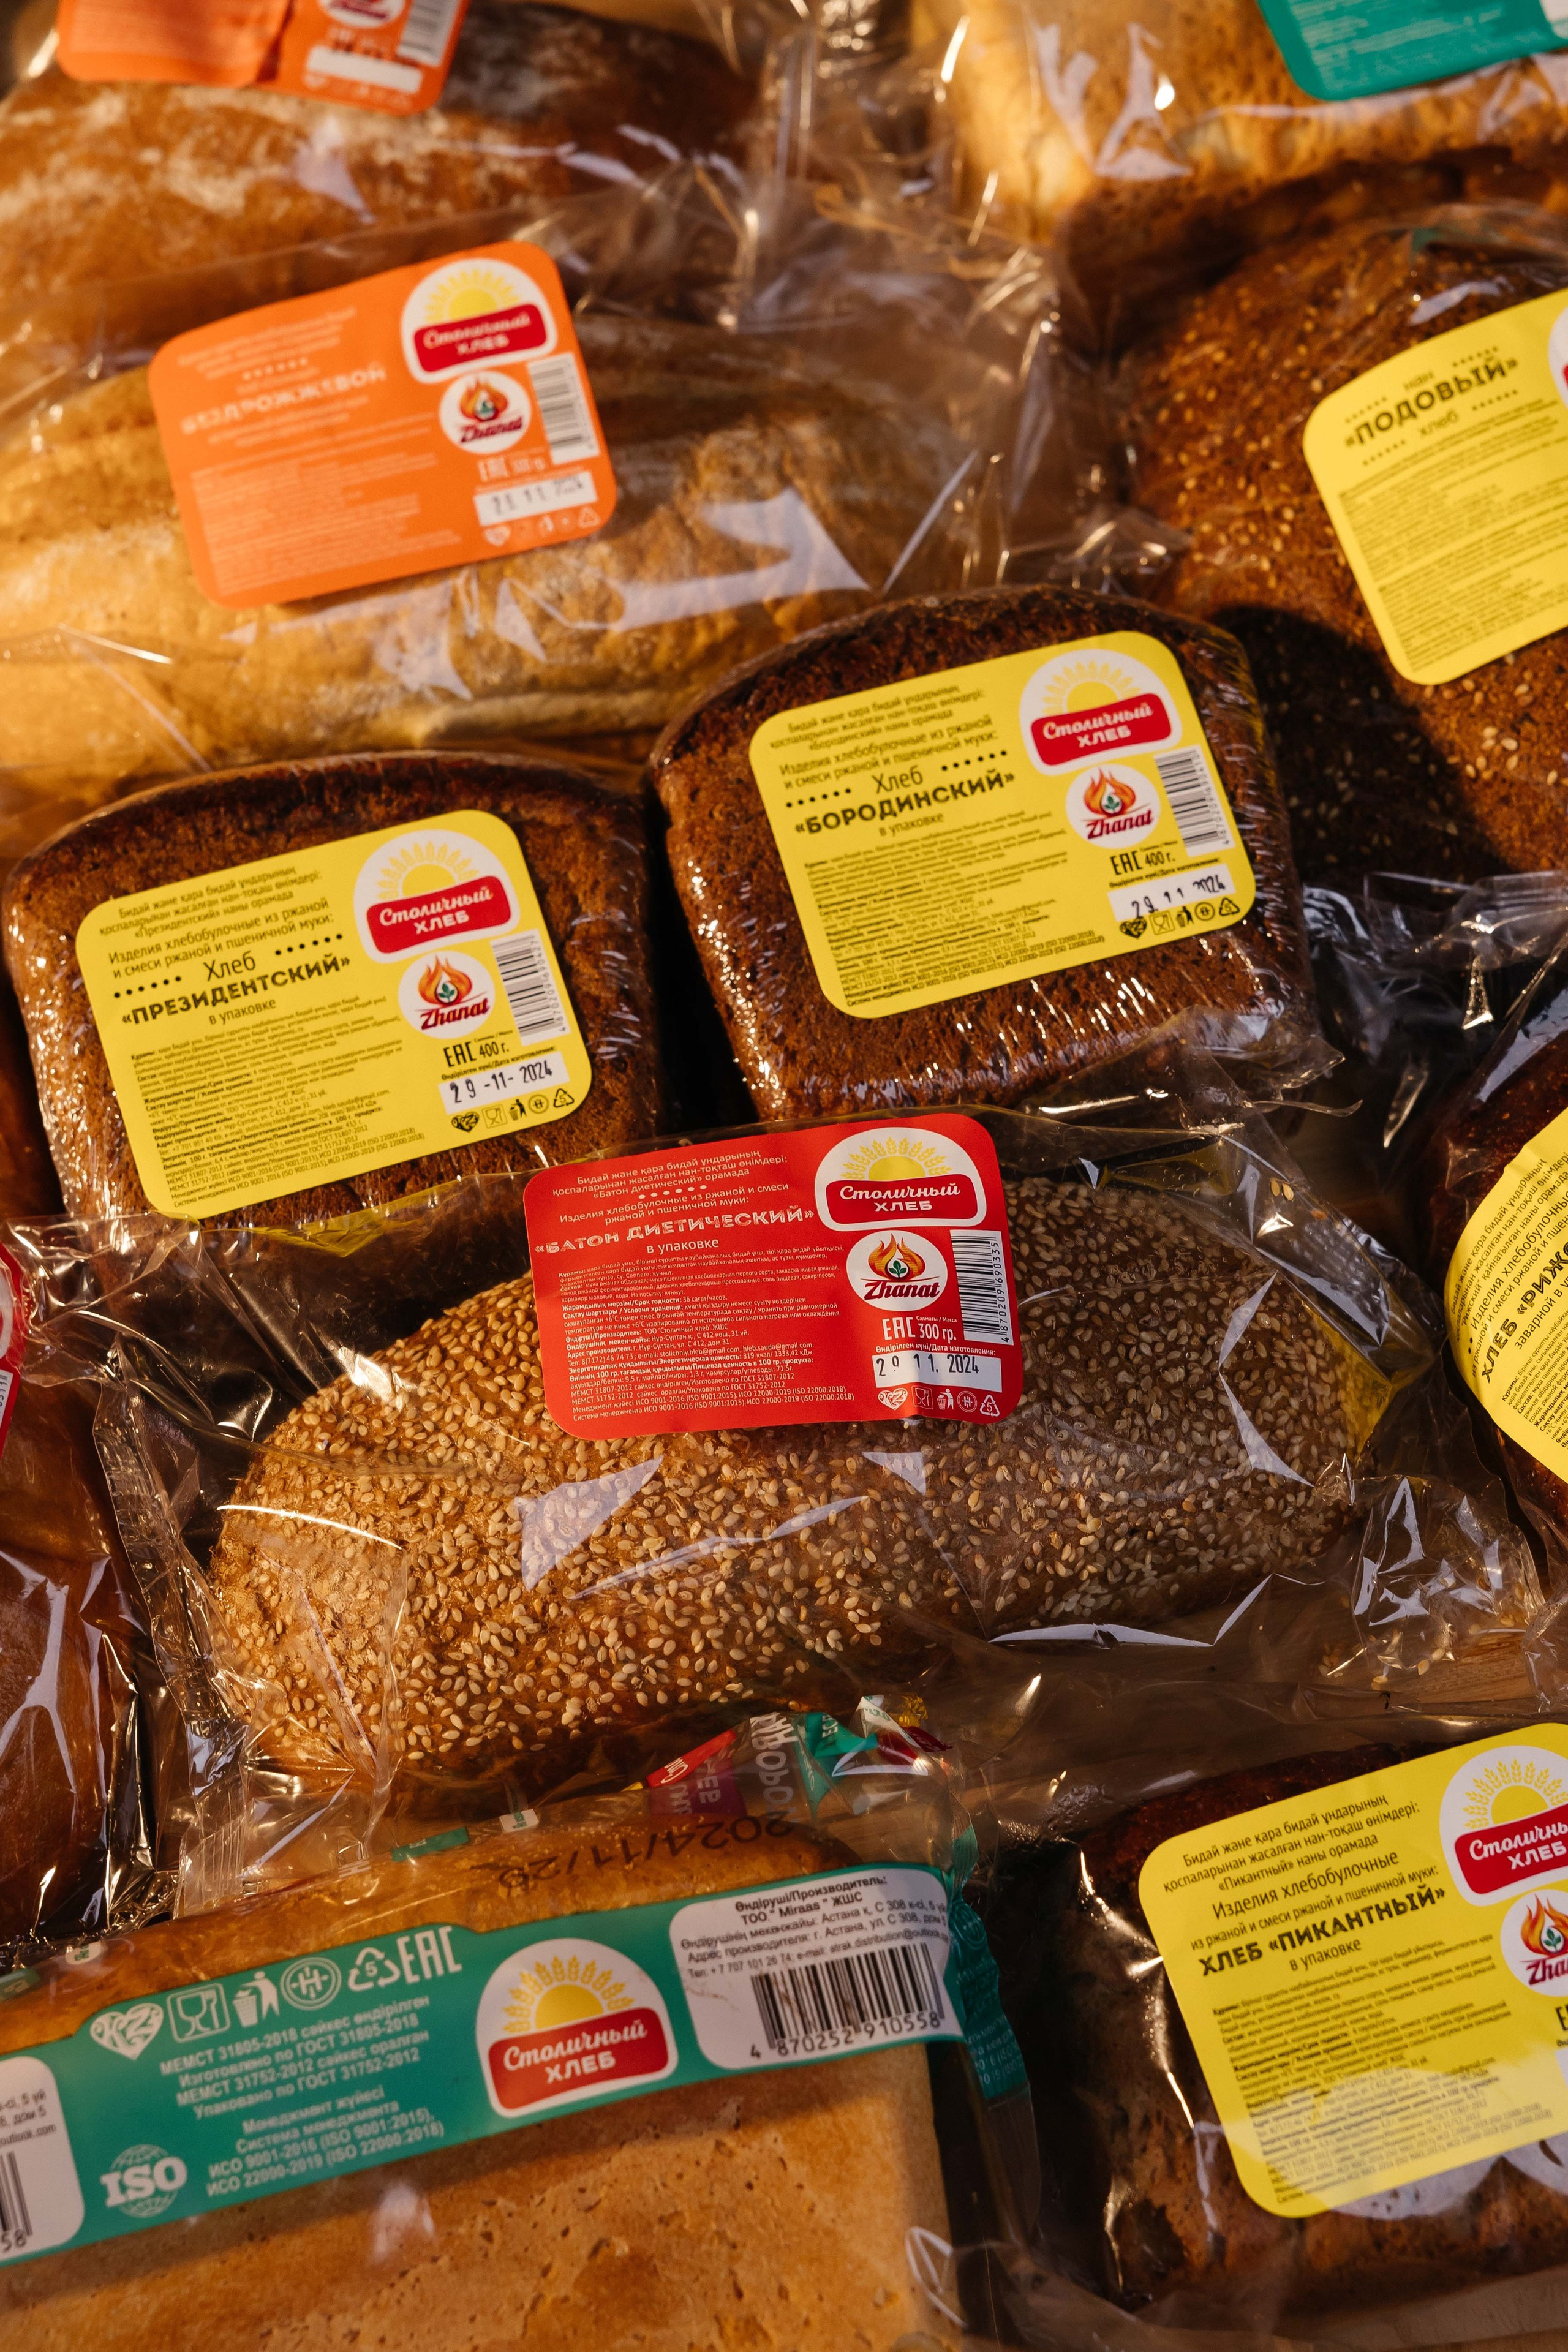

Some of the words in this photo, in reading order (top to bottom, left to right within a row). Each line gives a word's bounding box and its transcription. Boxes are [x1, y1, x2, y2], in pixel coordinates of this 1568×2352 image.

[1346, 359, 1518, 446] «ПОДОВЫЙ»
[1042, 702, 1153, 740] Столичный
[1075, 729, 1131, 748] ХЛЕБ
[872, 764, 924, 794] Хлеб
[795, 768, 1014, 834] «БОРОДИНСКИЙ»
[878, 826, 887, 837] в
[888, 813, 943, 837] упаковке
[1085, 809, 1152, 840] Zhanat
[1144, 850, 1165, 867] 400
[1165, 851, 1175, 863] г.
[379, 886, 493, 927] Столичный
[413, 914, 470, 935] ХЛЕБ
[107, 943, 162, 965] Изделия
[164, 916, 261, 951] хлебобулочные
[263, 912, 279, 924] из
[281, 897, 329, 922] ржаной
[112, 968, 122, 979] и
[124, 958, 162, 976] смеси
[164, 942, 212, 968] ржаной
[214, 942, 223, 952] и
[225, 923, 296, 949] пшеничной
[298, 913, 334, 931] муки:
[203, 950, 256, 982] Хлеб
[121, 952, 350, 1025] «ПРЕЗИДЕНТСКИЙ»
[208, 1014, 217, 1025] в
[218, 999, 276, 1024] упаковке
[420, 998, 489, 1030] Zhanat
[478, 1041, 499, 1058] 400
[500, 1042, 510, 1054] г.
[552, 1179, 627, 1197] қоспаларынан
[628, 1171, 676, 1185] жасалған
[677, 1161, 737, 1177] нан-тоқташ
[738, 1154, 788, 1167] өнімдері:
[576, 1172, 609, 1185] Бидай
[611, 1169, 638, 1180] және
[640, 1164, 664, 1175] қара
[666, 1157, 698, 1170] бидай
[699, 1150, 761, 1166] ұндарының
[592, 1187, 628, 1199] «Батон
[630, 1174, 703, 1194] диетический»
[704, 1168, 750, 1182] орамада
[559, 1210, 604, 1223] Изделия
[606, 1195, 688, 1215] хлебобулочные
[704, 1185, 745, 1203] ржаной
[756, 1183, 789, 1193] смеси
[839, 1182, 961, 1200] Столичный
[873, 1200, 933, 1212] ХЛЕБ
[533, 1232, 619, 1253] «БАТОН
[626, 1205, 815, 1242] ДИЕТИЧЕСКИЙ»
[604, 1208, 645, 1226] ржаной
[656, 1197, 717, 1214] пшеничной
[719, 1196, 749, 1207] муки:
[646, 1245, 654, 1254] в
[657, 1238, 719, 1255] упаковке
[990, 1242, 1004, 1283] 690335
[561, 1302, 607, 1312] Жарамдылық
[606, 1298, 650, 1308] мерзімі/Срок
[690, 1294, 726, 1302] сағат/часов.
[863, 1278, 940, 1301] Zhanat
[1471, 1277, 1504, 1330] Изделия
[1473, 1320, 1489, 1365] ржаной
[1488, 1314, 1494, 1323] и
[1492, 1283, 1515, 1314] смеси
[1512, 1246, 1543, 1286] ржаной
[1541, 1240, 1548, 1248] и
[996, 1289, 1009, 1332] 870209
[1515, 1296, 1556, 1350] заварной
[1554, 1289, 1563, 1298] в
[875, 1343, 913, 1353] Өндірілген
[912, 1343, 948, 1352] күні/Дата
[949, 1345, 996, 1355] изготовления:
[917, 1322, 940, 1340] 300
[941, 1327, 957, 1344] гр.
[1481, 1318, 1518, 1384] ХЛЕБ
[875, 1357, 886, 1377] 2
[946, 1352, 980, 1374] 2024
[570, 1387, 593, 1398] МЕМСТ
[594, 1384, 633, 1395] 31807-2012
[655, 1377, 730, 1389] өндірілген/Изготовлено
[739, 1374, 755, 1382] ГОСТ
[756, 1371, 794, 1382] 31807-2012
[1163, 1856, 1247, 1893] қоспаларынан
[1247, 1839, 1302, 1864] жасалған
[1303, 1820, 1364, 1847] нан-тоқаш
[1365, 1802, 1420, 1827] өнімдері:
[1182, 1844, 1221, 1867] Бидай
[1221, 1836, 1252, 1855] және
[1253, 1827, 1283, 1844] қара
[1283, 1815, 1320, 1834] бидай
[1320, 1794, 1389, 1825] ұндарының
[1218, 1859, 1294, 1891] «Пикантный»
[1295, 1850, 1327, 1868] наны
[1328, 1833, 1378, 1858] орамада
[1507, 1841, 1567, 1870] ХЛЕБ
[734, 1875, 888, 1912] Өндіруші/Производитель:
[1211, 1888, 1279, 1920] Изделия
[1280, 1851, 1399, 1899] хлебобулочные
[740, 1910, 768, 1924] ТОО
[778, 1901, 821, 1918] Miraas
[830, 1891, 863, 1907] ЖШС
[1189, 1938, 1204, 1950] из
[1205, 1921, 1248, 1948] ржаной
[1248, 1921, 1257, 1932] и
[1257, 1910, 1292, 1929] смеси
[1292, 1895, 1335, 1921] ржаной
[1335, 1894, 1344, 1905] и
[1344, 1873, 1406, 1902] пшеничной
[1407, 1864, 1439, 1883] муки:
[1199, 1941, 1263, 1977] ХЛЕБ
[1268, 1883, 1445, 1951] «ПИКАНТНЫЙ»
[1288, 1959, 1298, 1971] в
[1299, 1939, 1362, 1970] упаковке
[502, 2019, 648, 2071] Столичный
[750, 2043, 761, 2059] 4
[776, 2029, 853, 2057] 870252
[862, 2010, 940, 2039] 910558
[544, 2056, 616, 2084] ХЛЕБ
[99, 2155, 187, 2207] ISO
